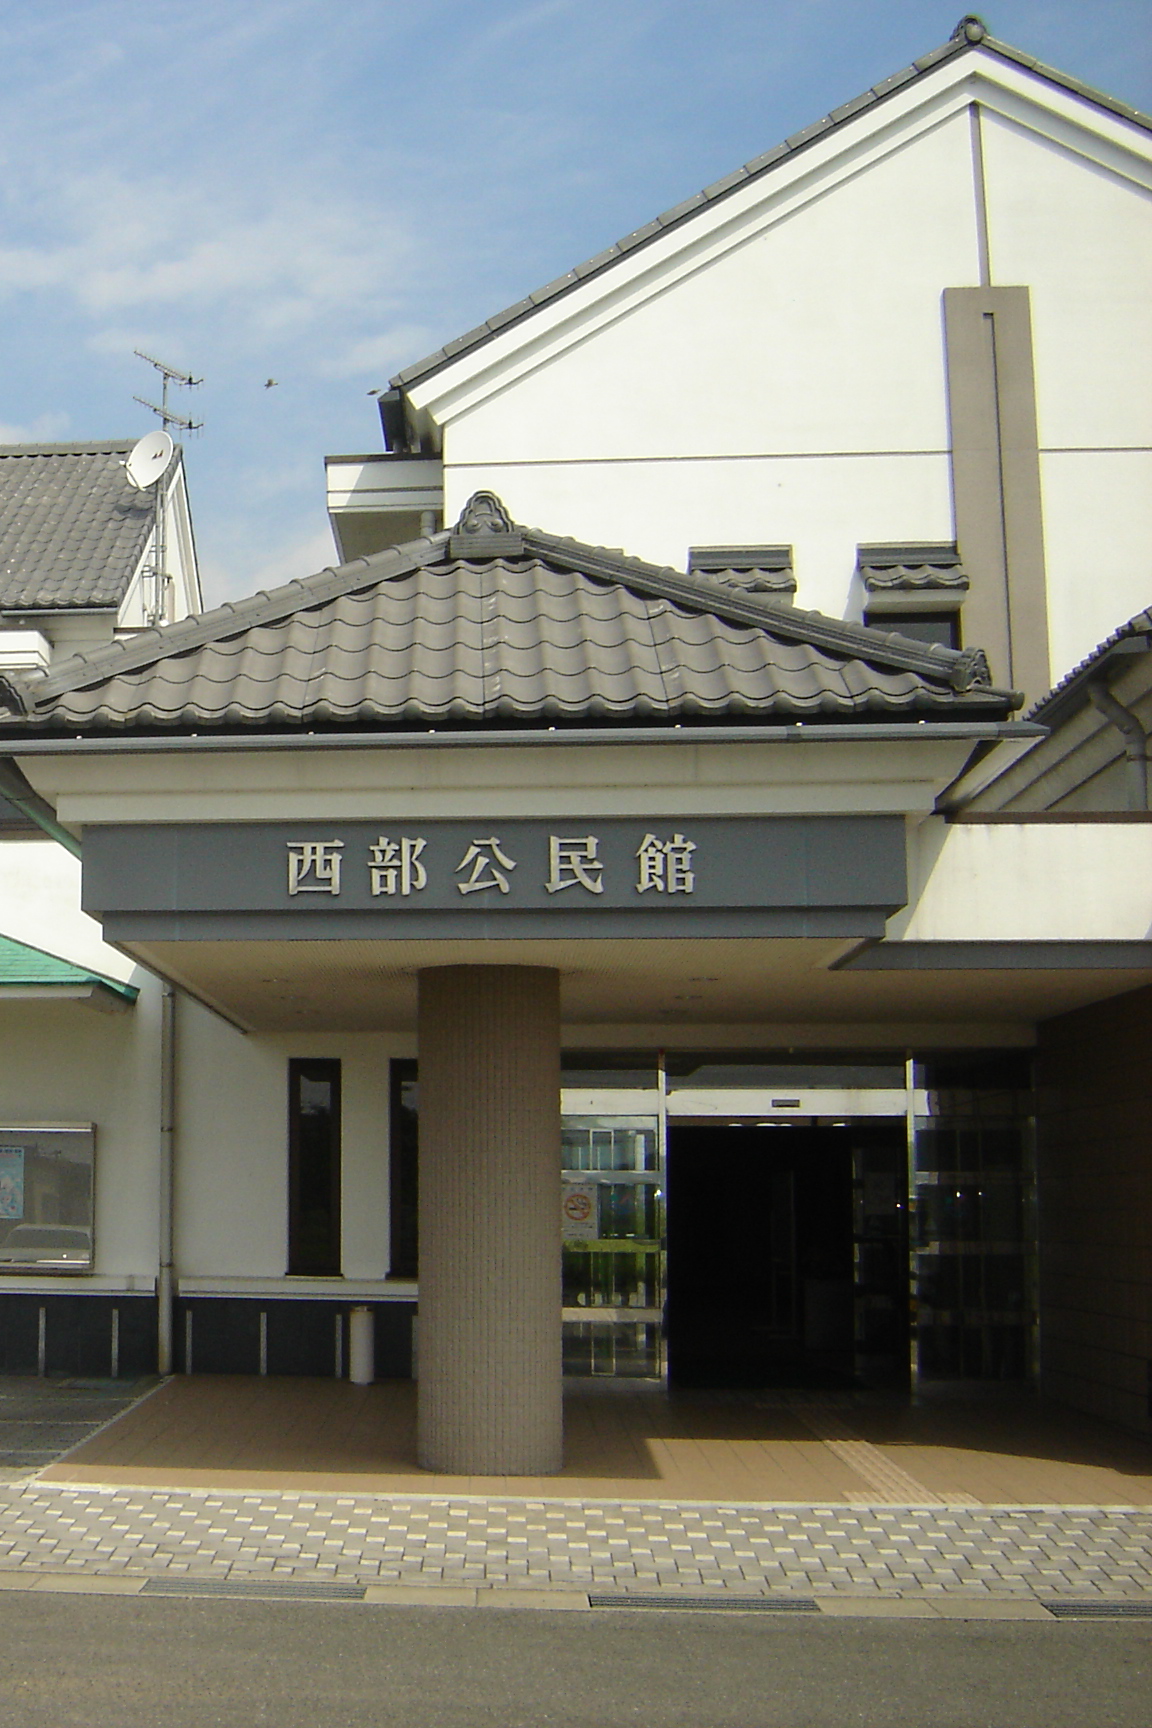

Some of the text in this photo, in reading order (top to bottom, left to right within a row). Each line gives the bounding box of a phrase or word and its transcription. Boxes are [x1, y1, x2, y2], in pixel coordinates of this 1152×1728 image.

[286, 834, 697, 895] 西部公民館
